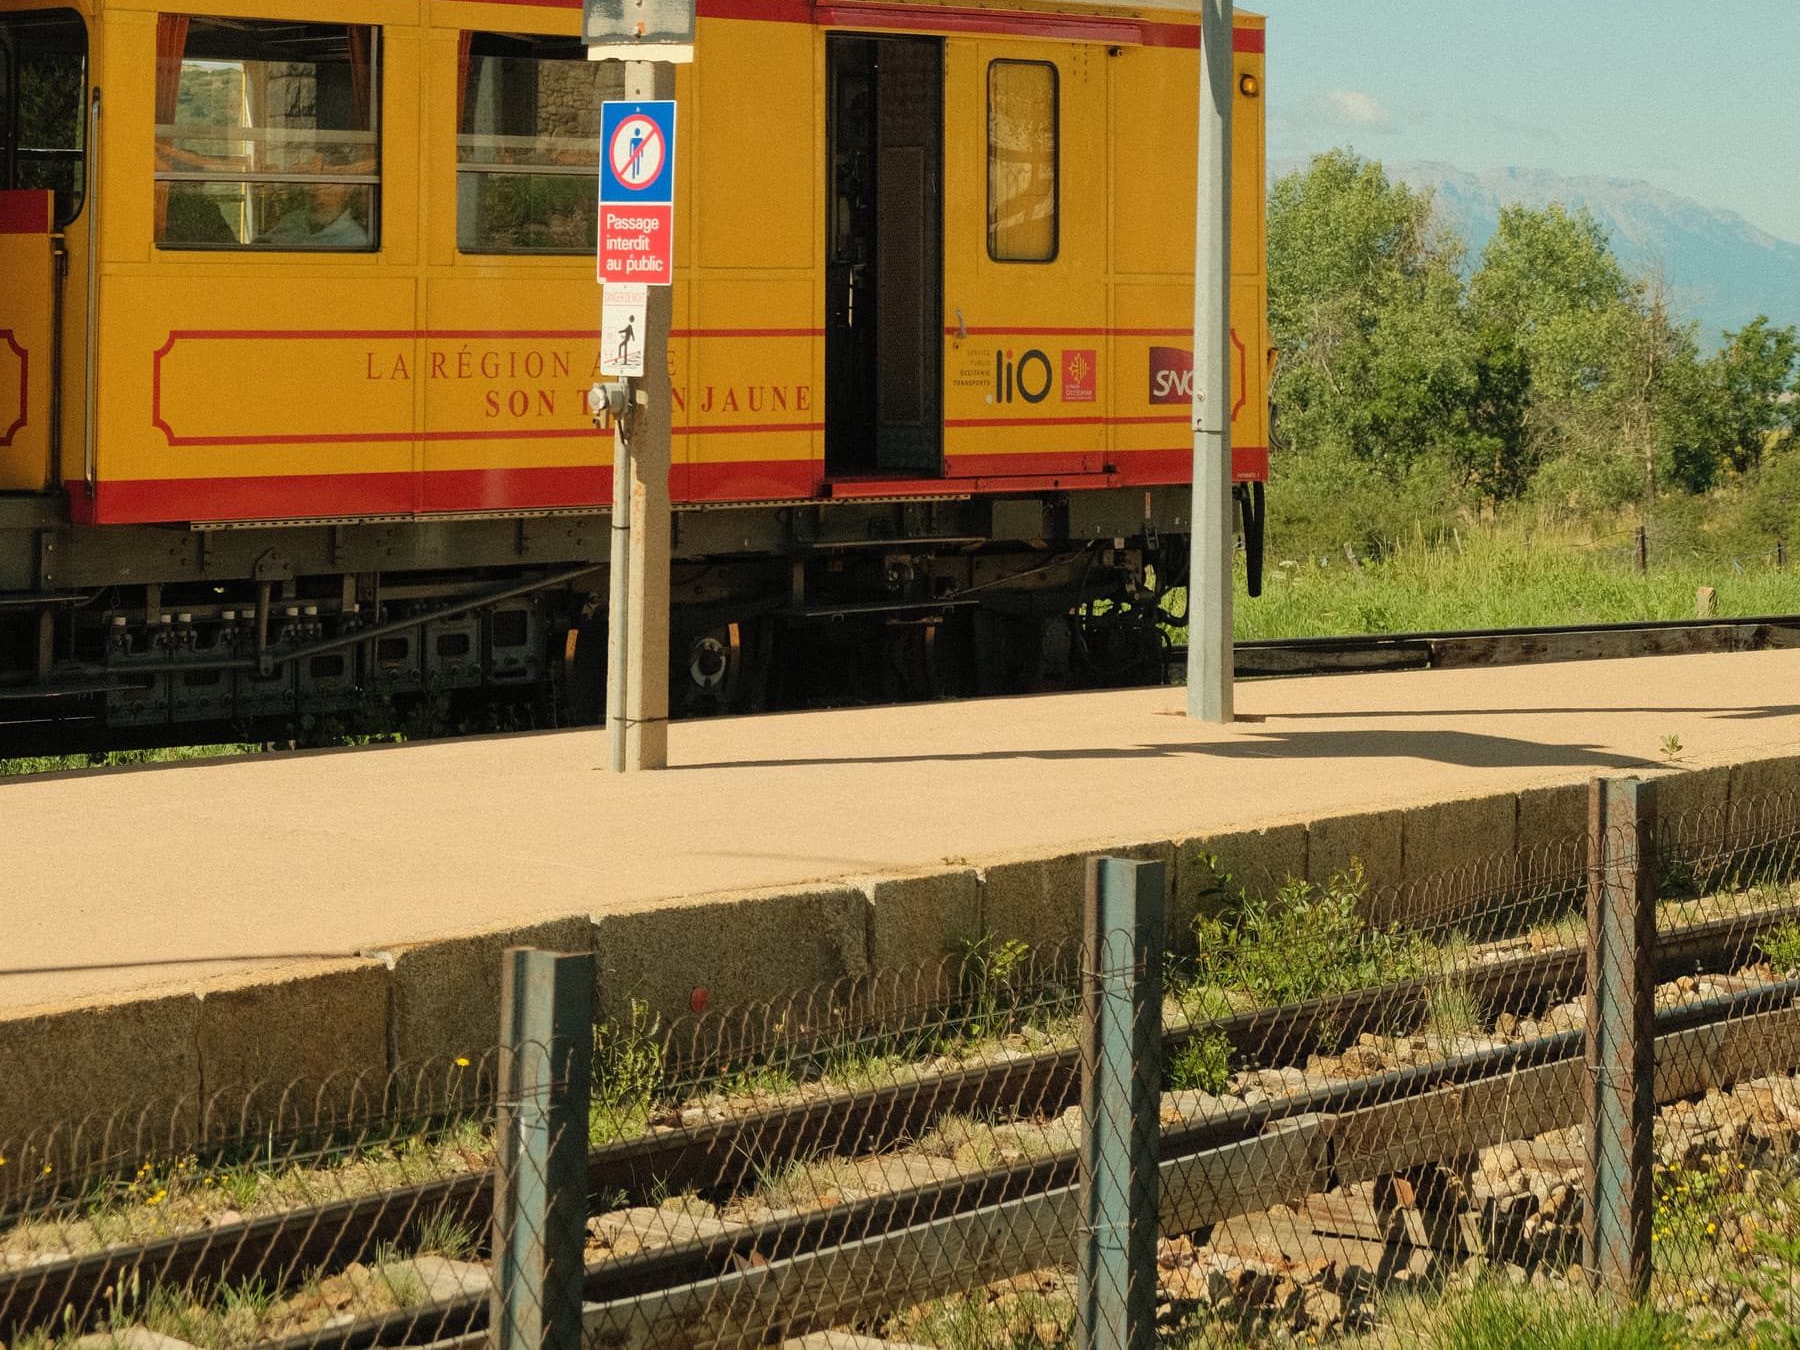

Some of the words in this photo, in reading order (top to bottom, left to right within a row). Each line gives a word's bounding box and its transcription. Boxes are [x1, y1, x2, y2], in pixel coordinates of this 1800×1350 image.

[606, 213, 660, 234] Passage
[606, 234, 650, 251] interdit
[606, 258, 622, 271] au
[626, 255, 664, 275] public
[366, 352, 411, 380] LA
[430, 344, 570, 378] RÉGION
[1153, 369, 1194, 397] SNC
[485, 389, 556, 417] SON
[701, 385, 811, 412] JAUNE
